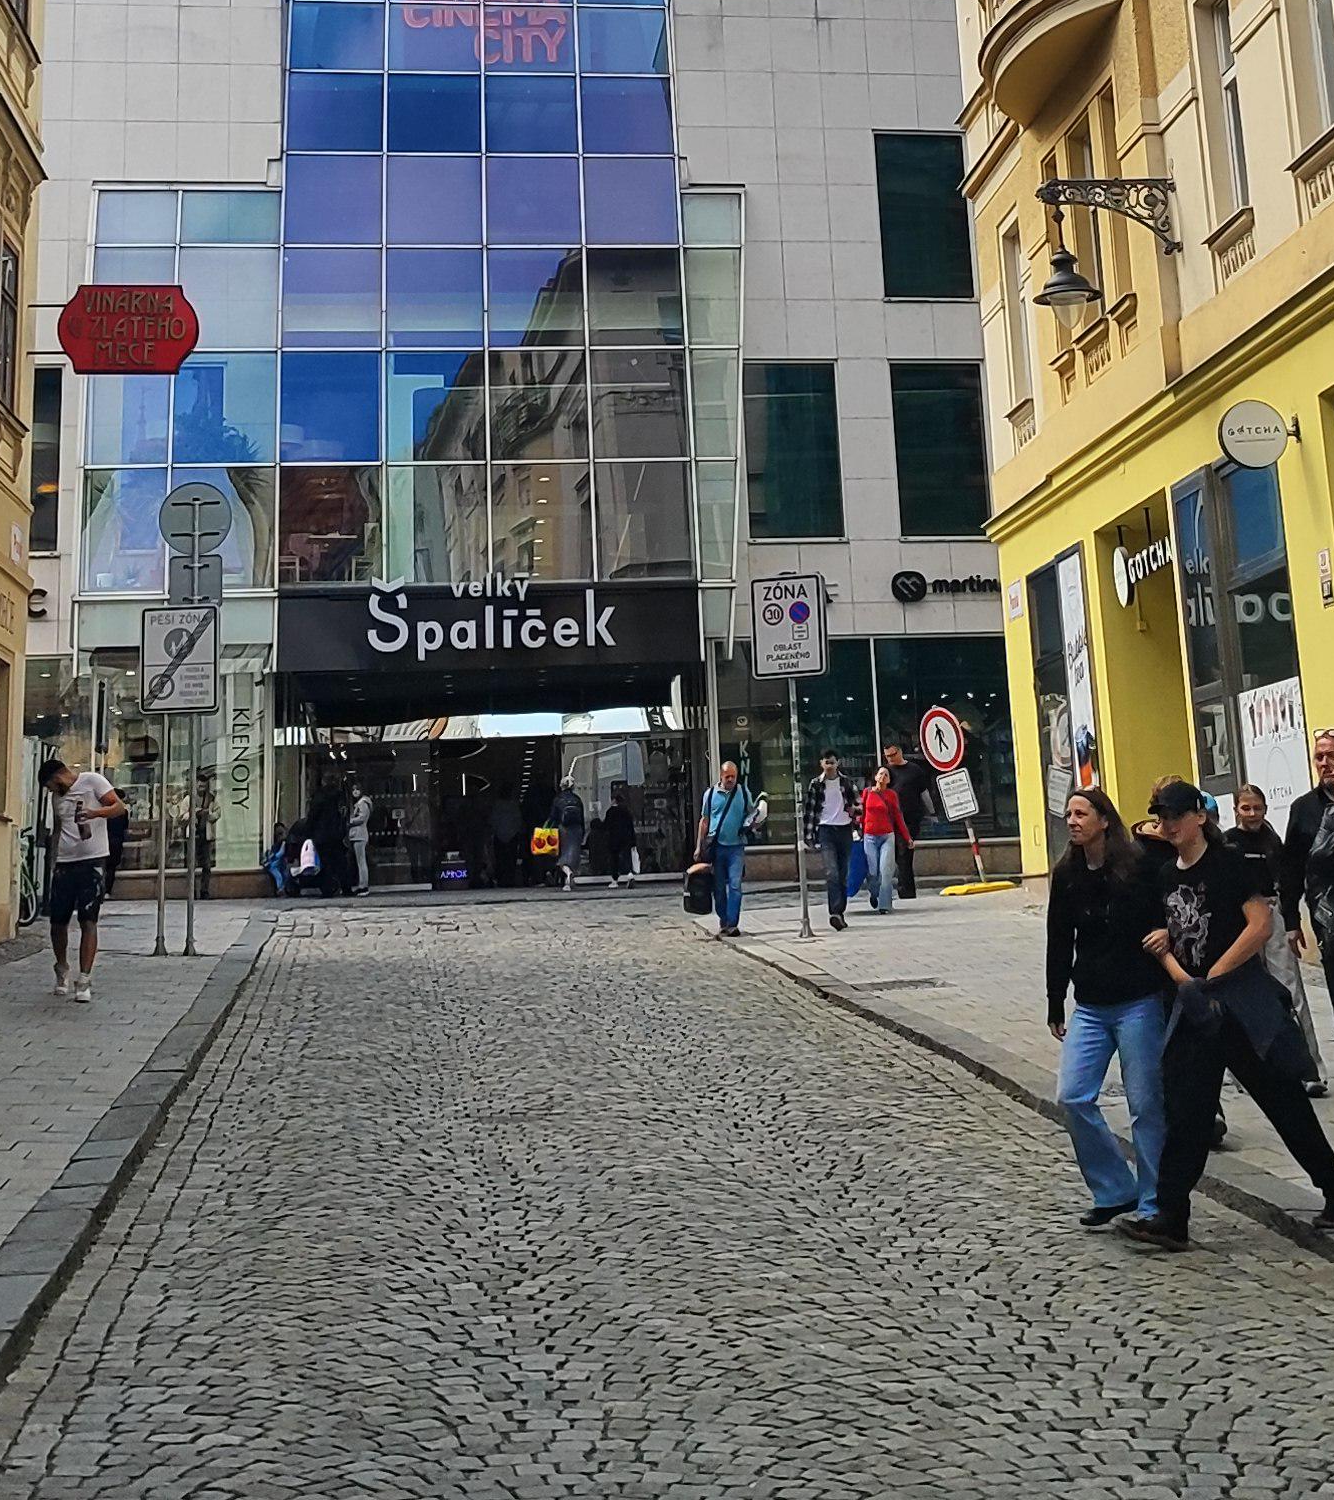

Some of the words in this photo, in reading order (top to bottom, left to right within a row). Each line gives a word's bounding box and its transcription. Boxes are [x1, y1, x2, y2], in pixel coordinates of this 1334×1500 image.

[474, 27, 566, 64] CITY
[1227, 425, 1282, 436] GOTCHA
[1127, 535, 1173, 584] GOTCHA
[763, 582, 808, 601] ZÓNA
[767, 609, 780, 620] 30
[773, 642, 802, 652] OBLAST
[766, 651, 811, 662] PLACENÉHO
[777, 661, 800, 671] STÁNÍ
[231, 708, 250, 810] KLENOTY
